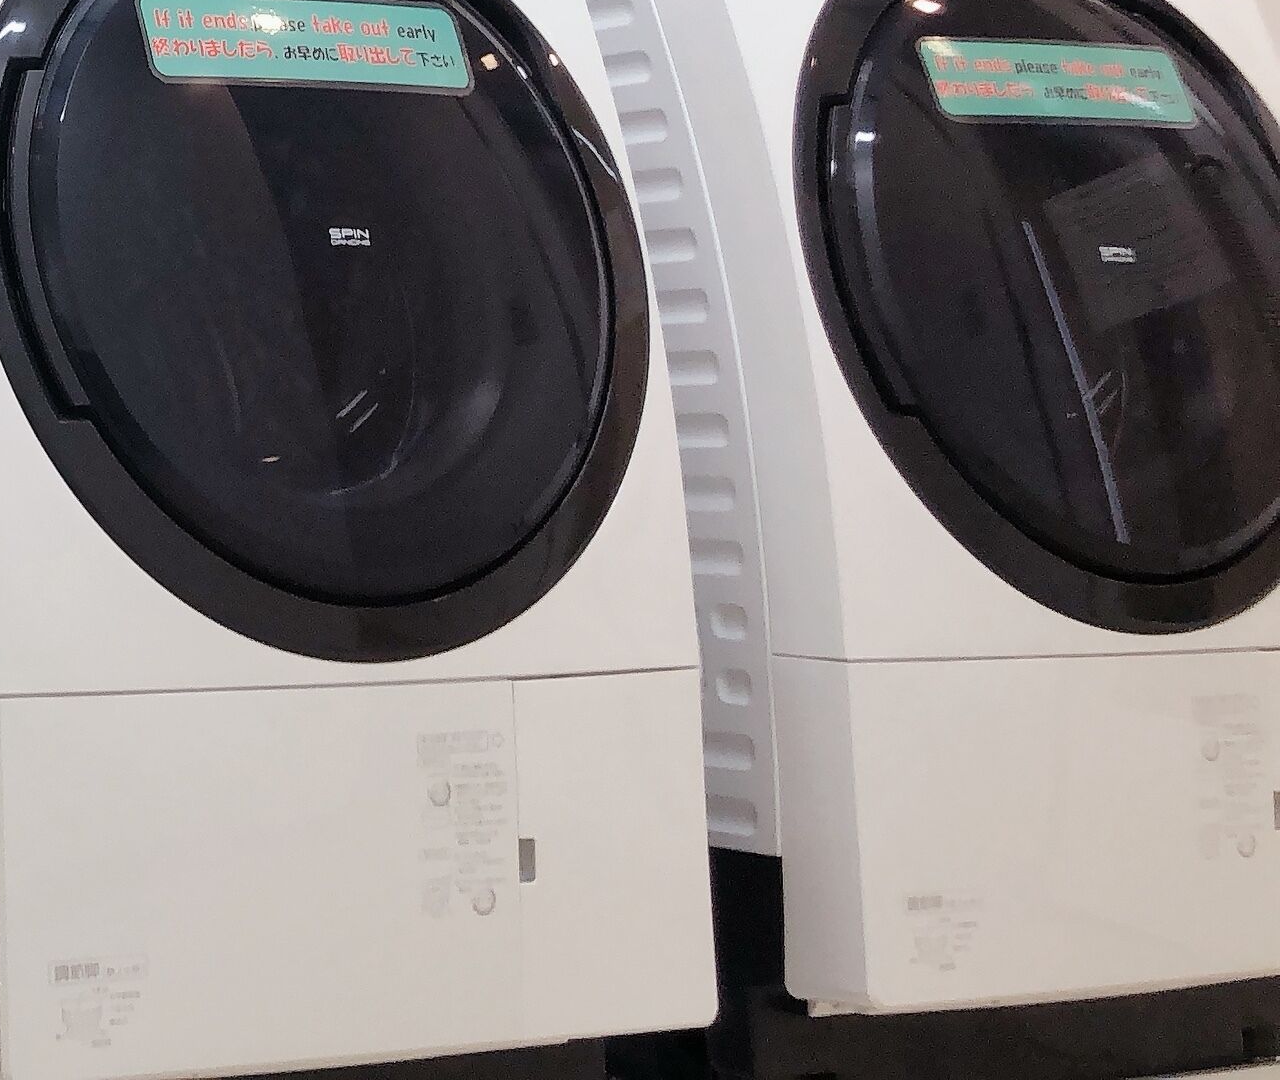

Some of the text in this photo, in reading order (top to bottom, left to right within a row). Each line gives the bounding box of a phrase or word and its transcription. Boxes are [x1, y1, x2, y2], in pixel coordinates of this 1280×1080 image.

[153, 9, 435, 42] If it ends take out early
[1014, 59, 1058, 75] please
[329, 228, 369, 239] SPIN
